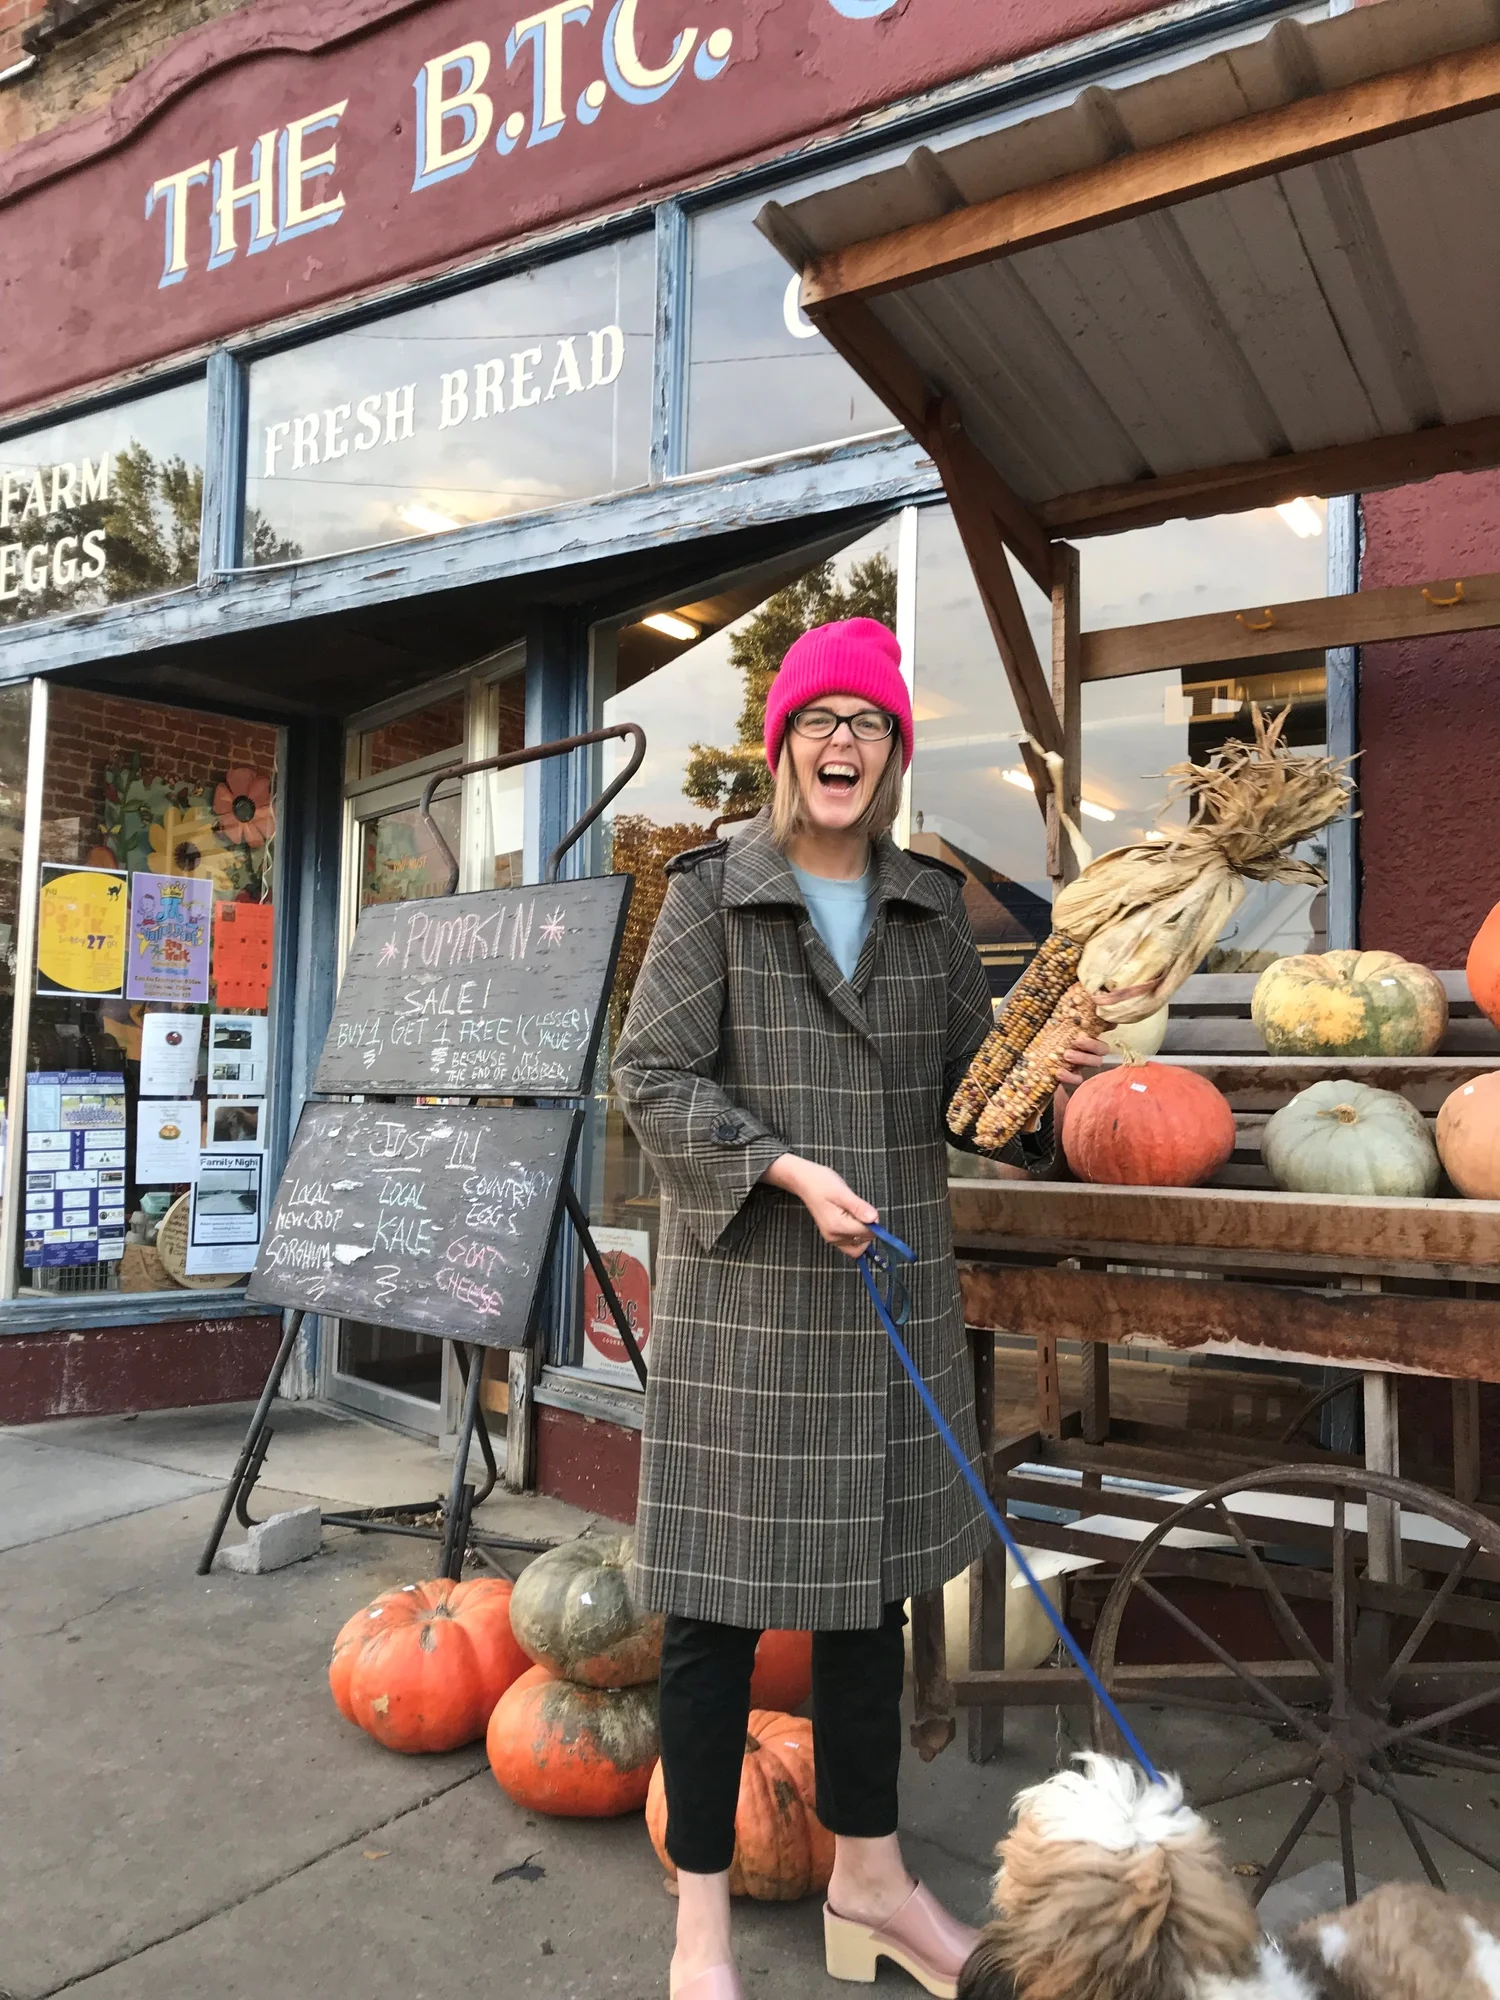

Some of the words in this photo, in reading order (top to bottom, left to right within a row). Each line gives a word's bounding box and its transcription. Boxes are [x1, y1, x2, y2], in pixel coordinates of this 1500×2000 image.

[146, 99, 348, 288] THE
[263, 384, 418, 479] FRESH
[438, 325, 627, 432] BREAD
[0, 451, 110, 529] FARM
[0, 528, 107, 600] EGGS
[86, 934, 106, 950] 27
[402, 898, 536, 970] PUMPKIN
[395, 979, 491, 1015] SALE!
[337, 1021, 365, 1049] BUY
[391, 1015, 428, 1046] GET
[445, 1068, 466, 1084] THE
[471, 1066, 491, 1080] END
[493, 1066, 508, 1081] OF
[451, 1049, 507, 1068] BECAUSE
[368, 1121, 432, 1160] JUST
[450, 1128, 482, 1166] IN
[200, 1158, 233, 1168] Family
[288, 1178, 331, 1206] LOCAL
[379, 1177, 428, 1210] LOCAL
[305, 1209, 344, 1232] CROP
[371, 1208, 432, 1256] KALE
[263, 1234, 331, 1275] SORGHUM
[446, 1235, 507, 1278] GOAT
